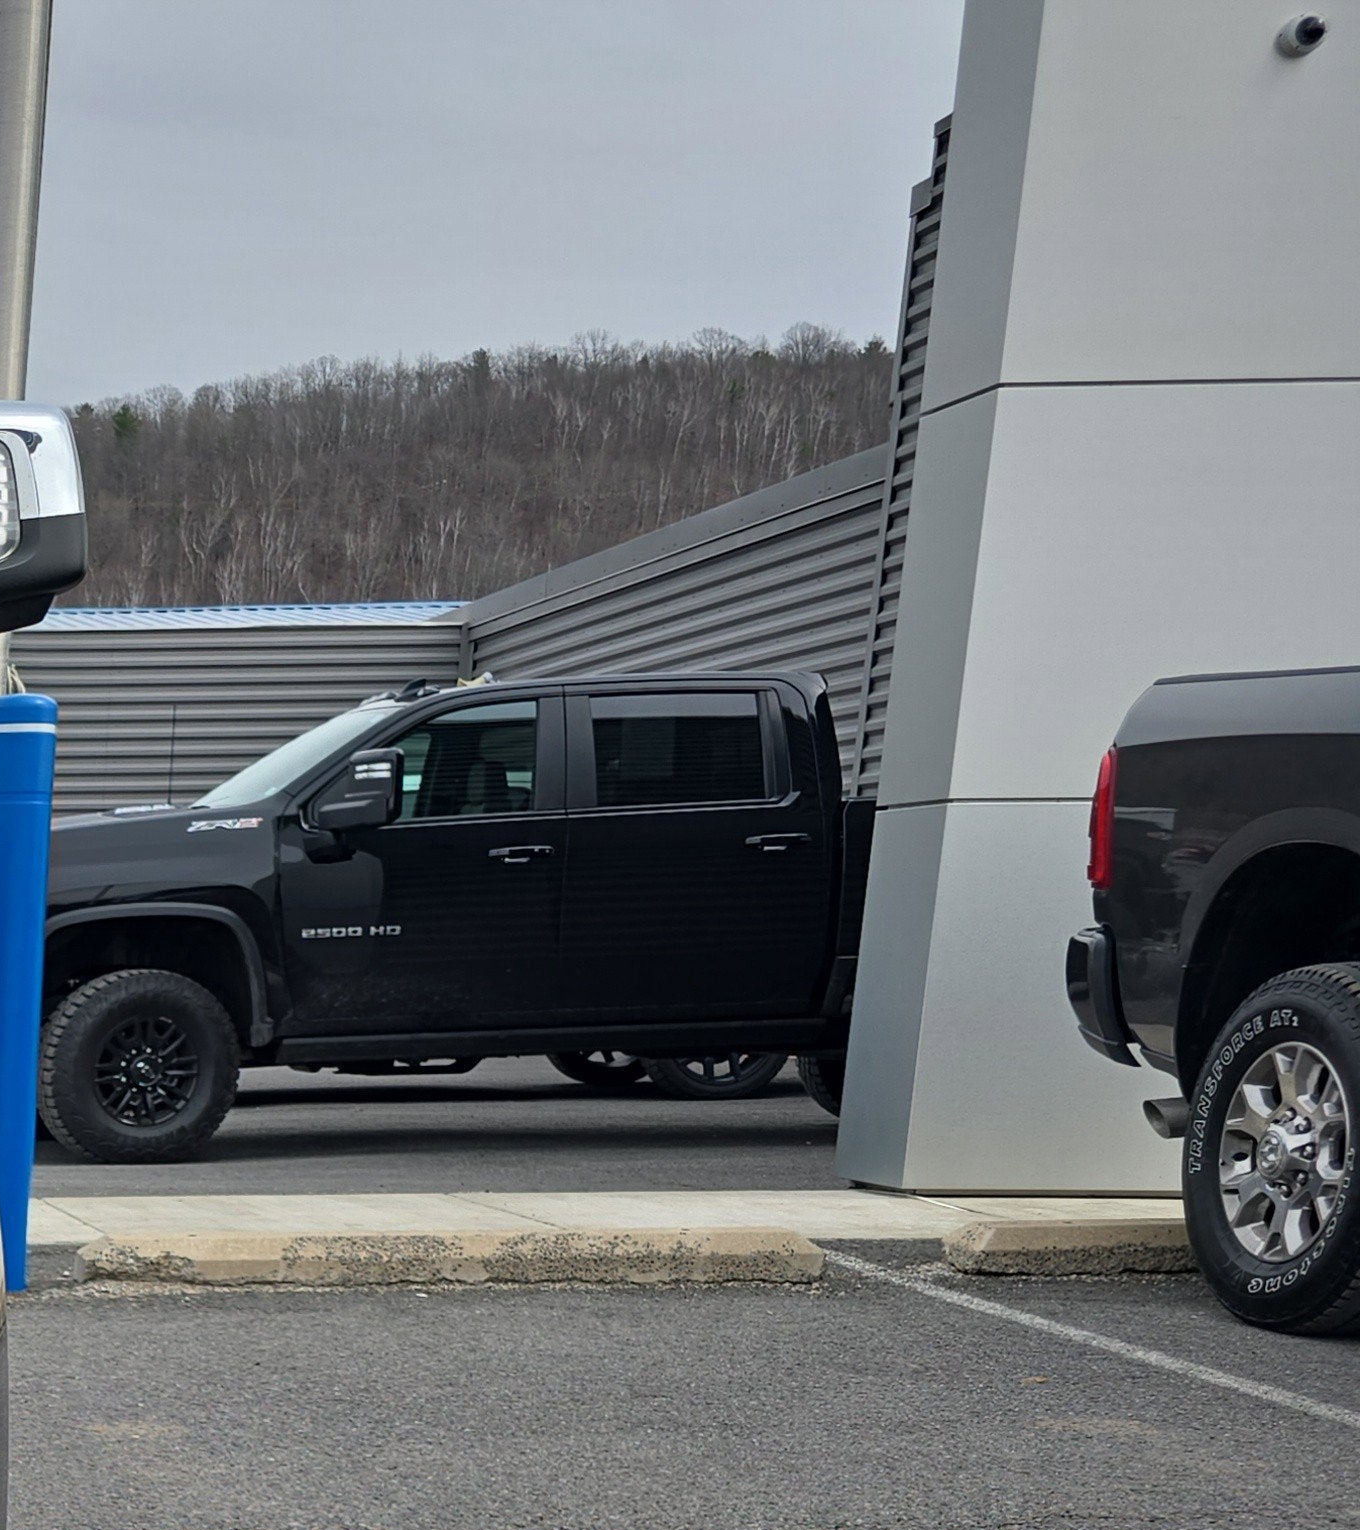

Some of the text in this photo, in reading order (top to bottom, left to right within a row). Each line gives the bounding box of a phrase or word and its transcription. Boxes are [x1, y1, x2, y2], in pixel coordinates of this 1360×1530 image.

[301, 925, 402, 939] 2500 HD
[1188, 1014, 1265, 1175] TRANSFORCE
